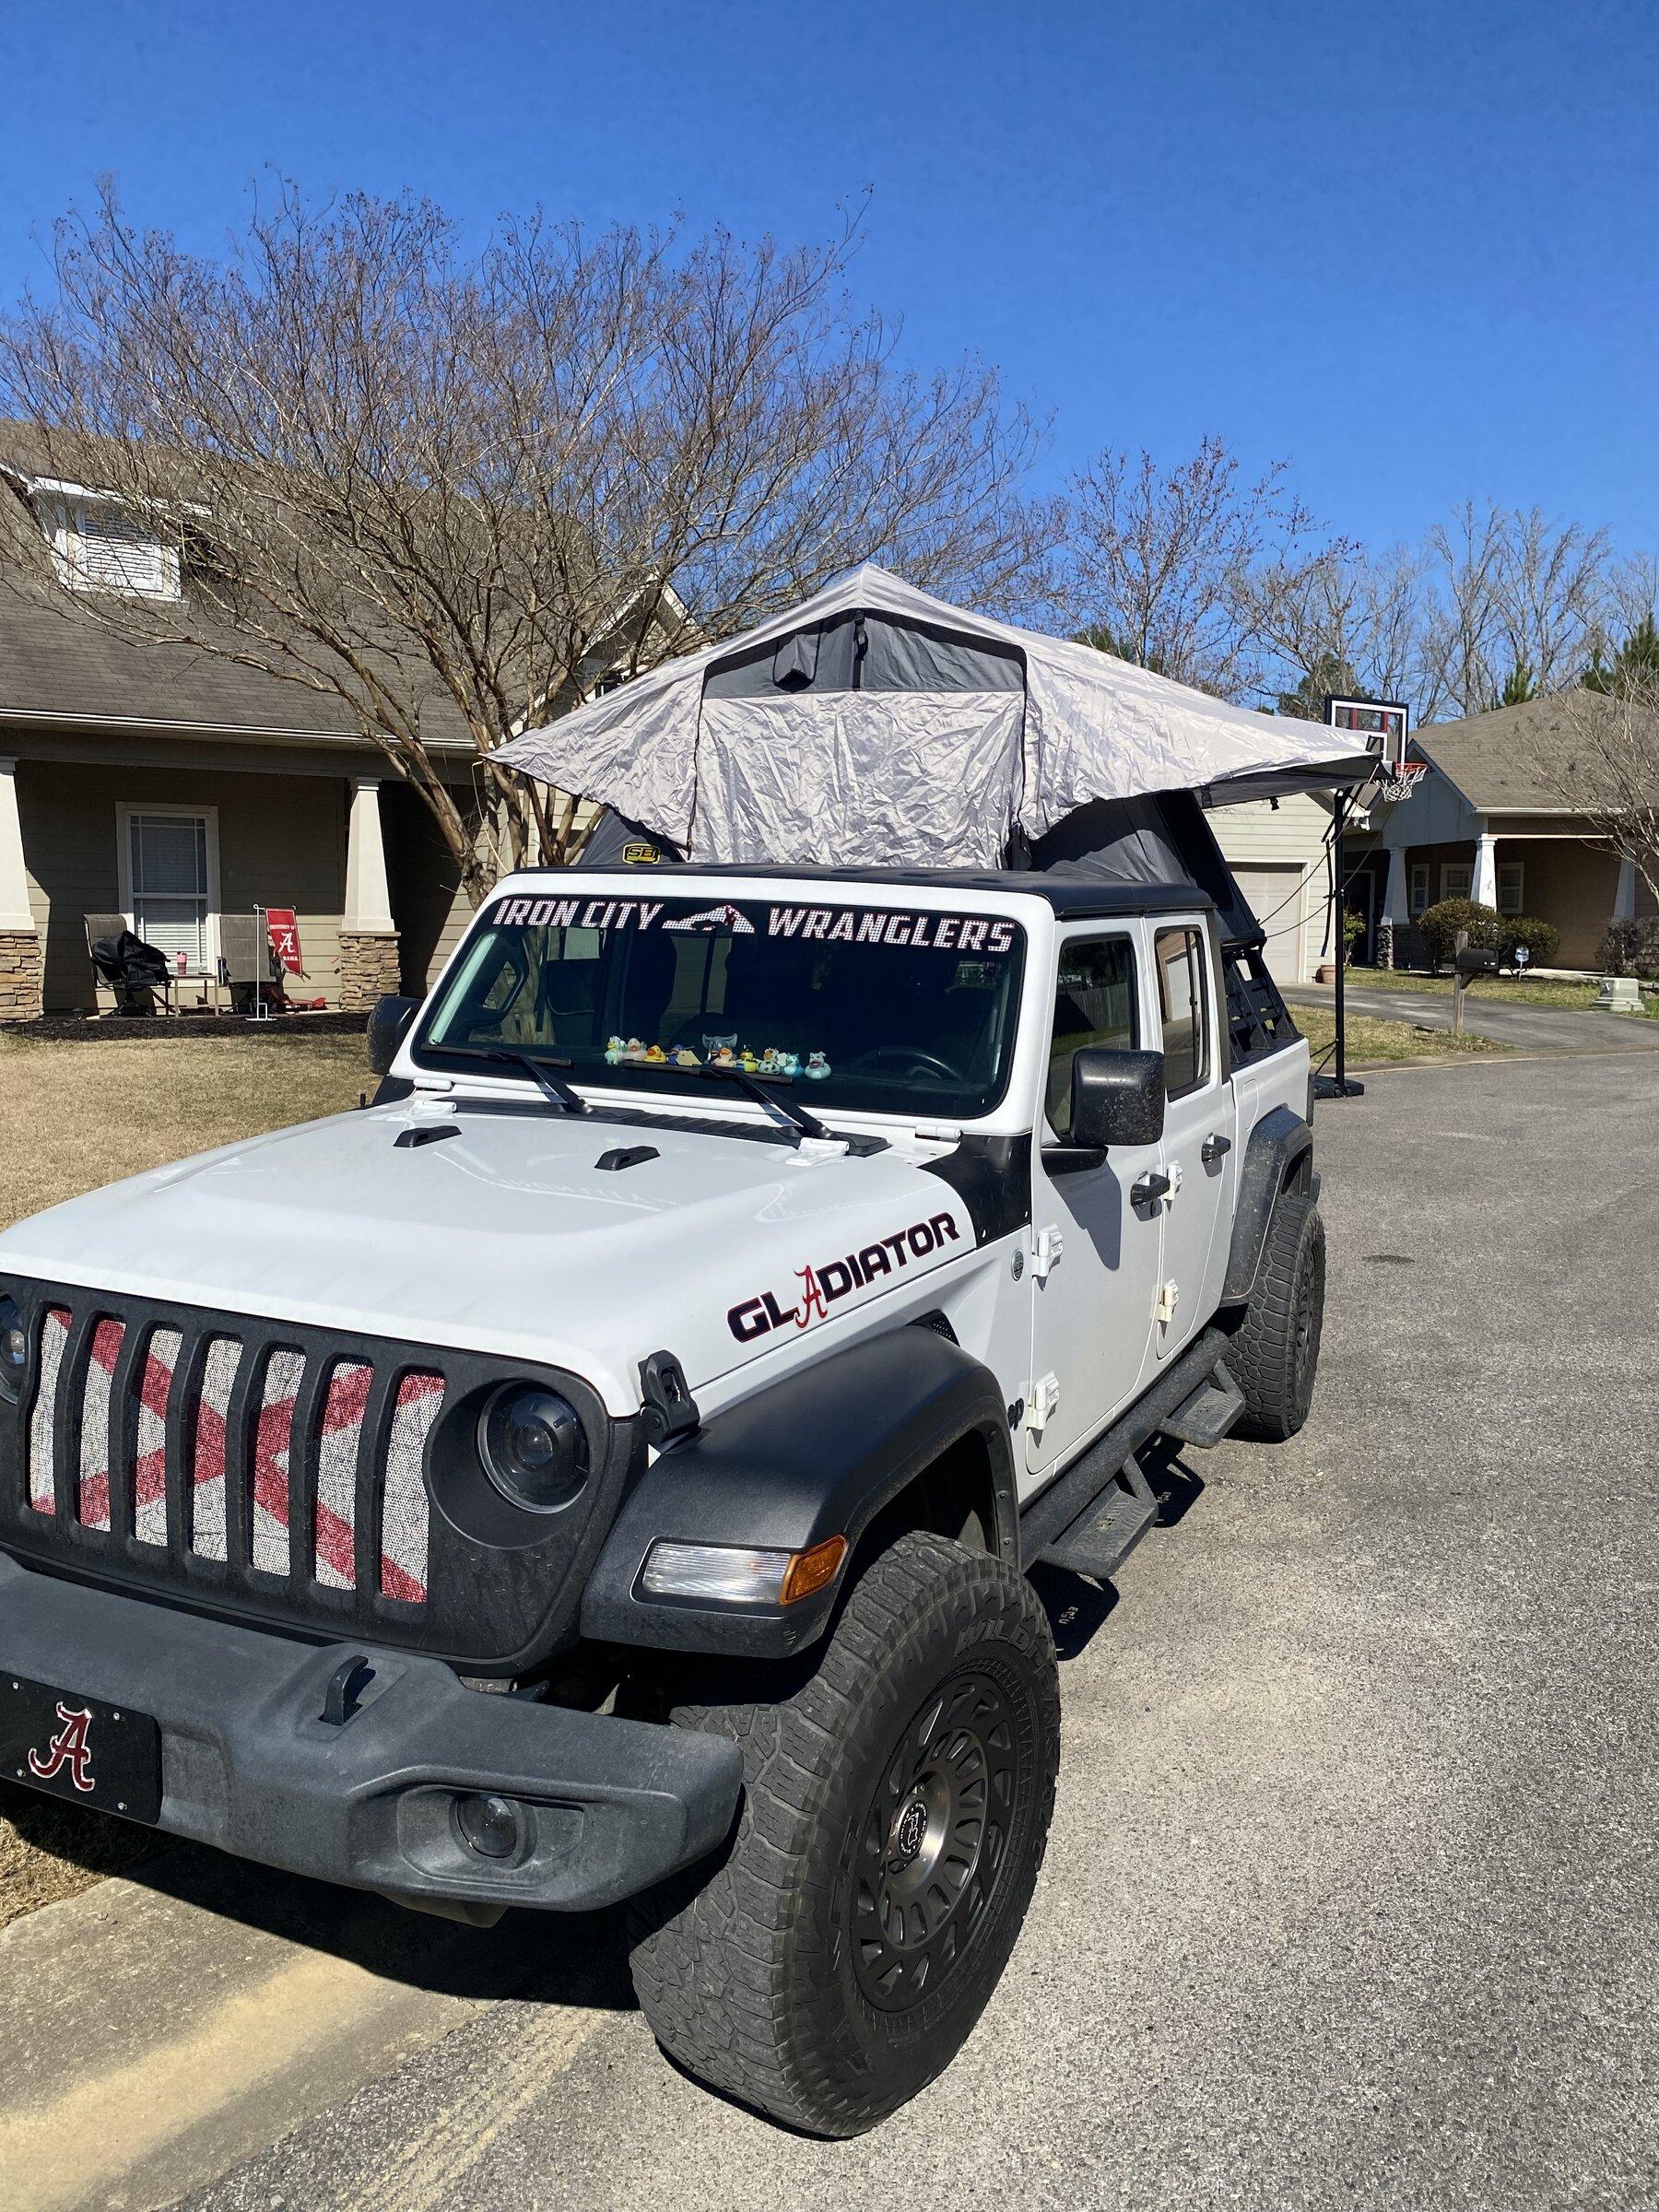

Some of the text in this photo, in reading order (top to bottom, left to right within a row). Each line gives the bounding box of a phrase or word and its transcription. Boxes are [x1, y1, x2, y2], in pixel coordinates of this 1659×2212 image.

[492, 898, 1016, 952] IRON CITY WRANGLERS
[727, 1211, 960, 1343] GLADIATOR
[28, 1700, 96, 1792] A
